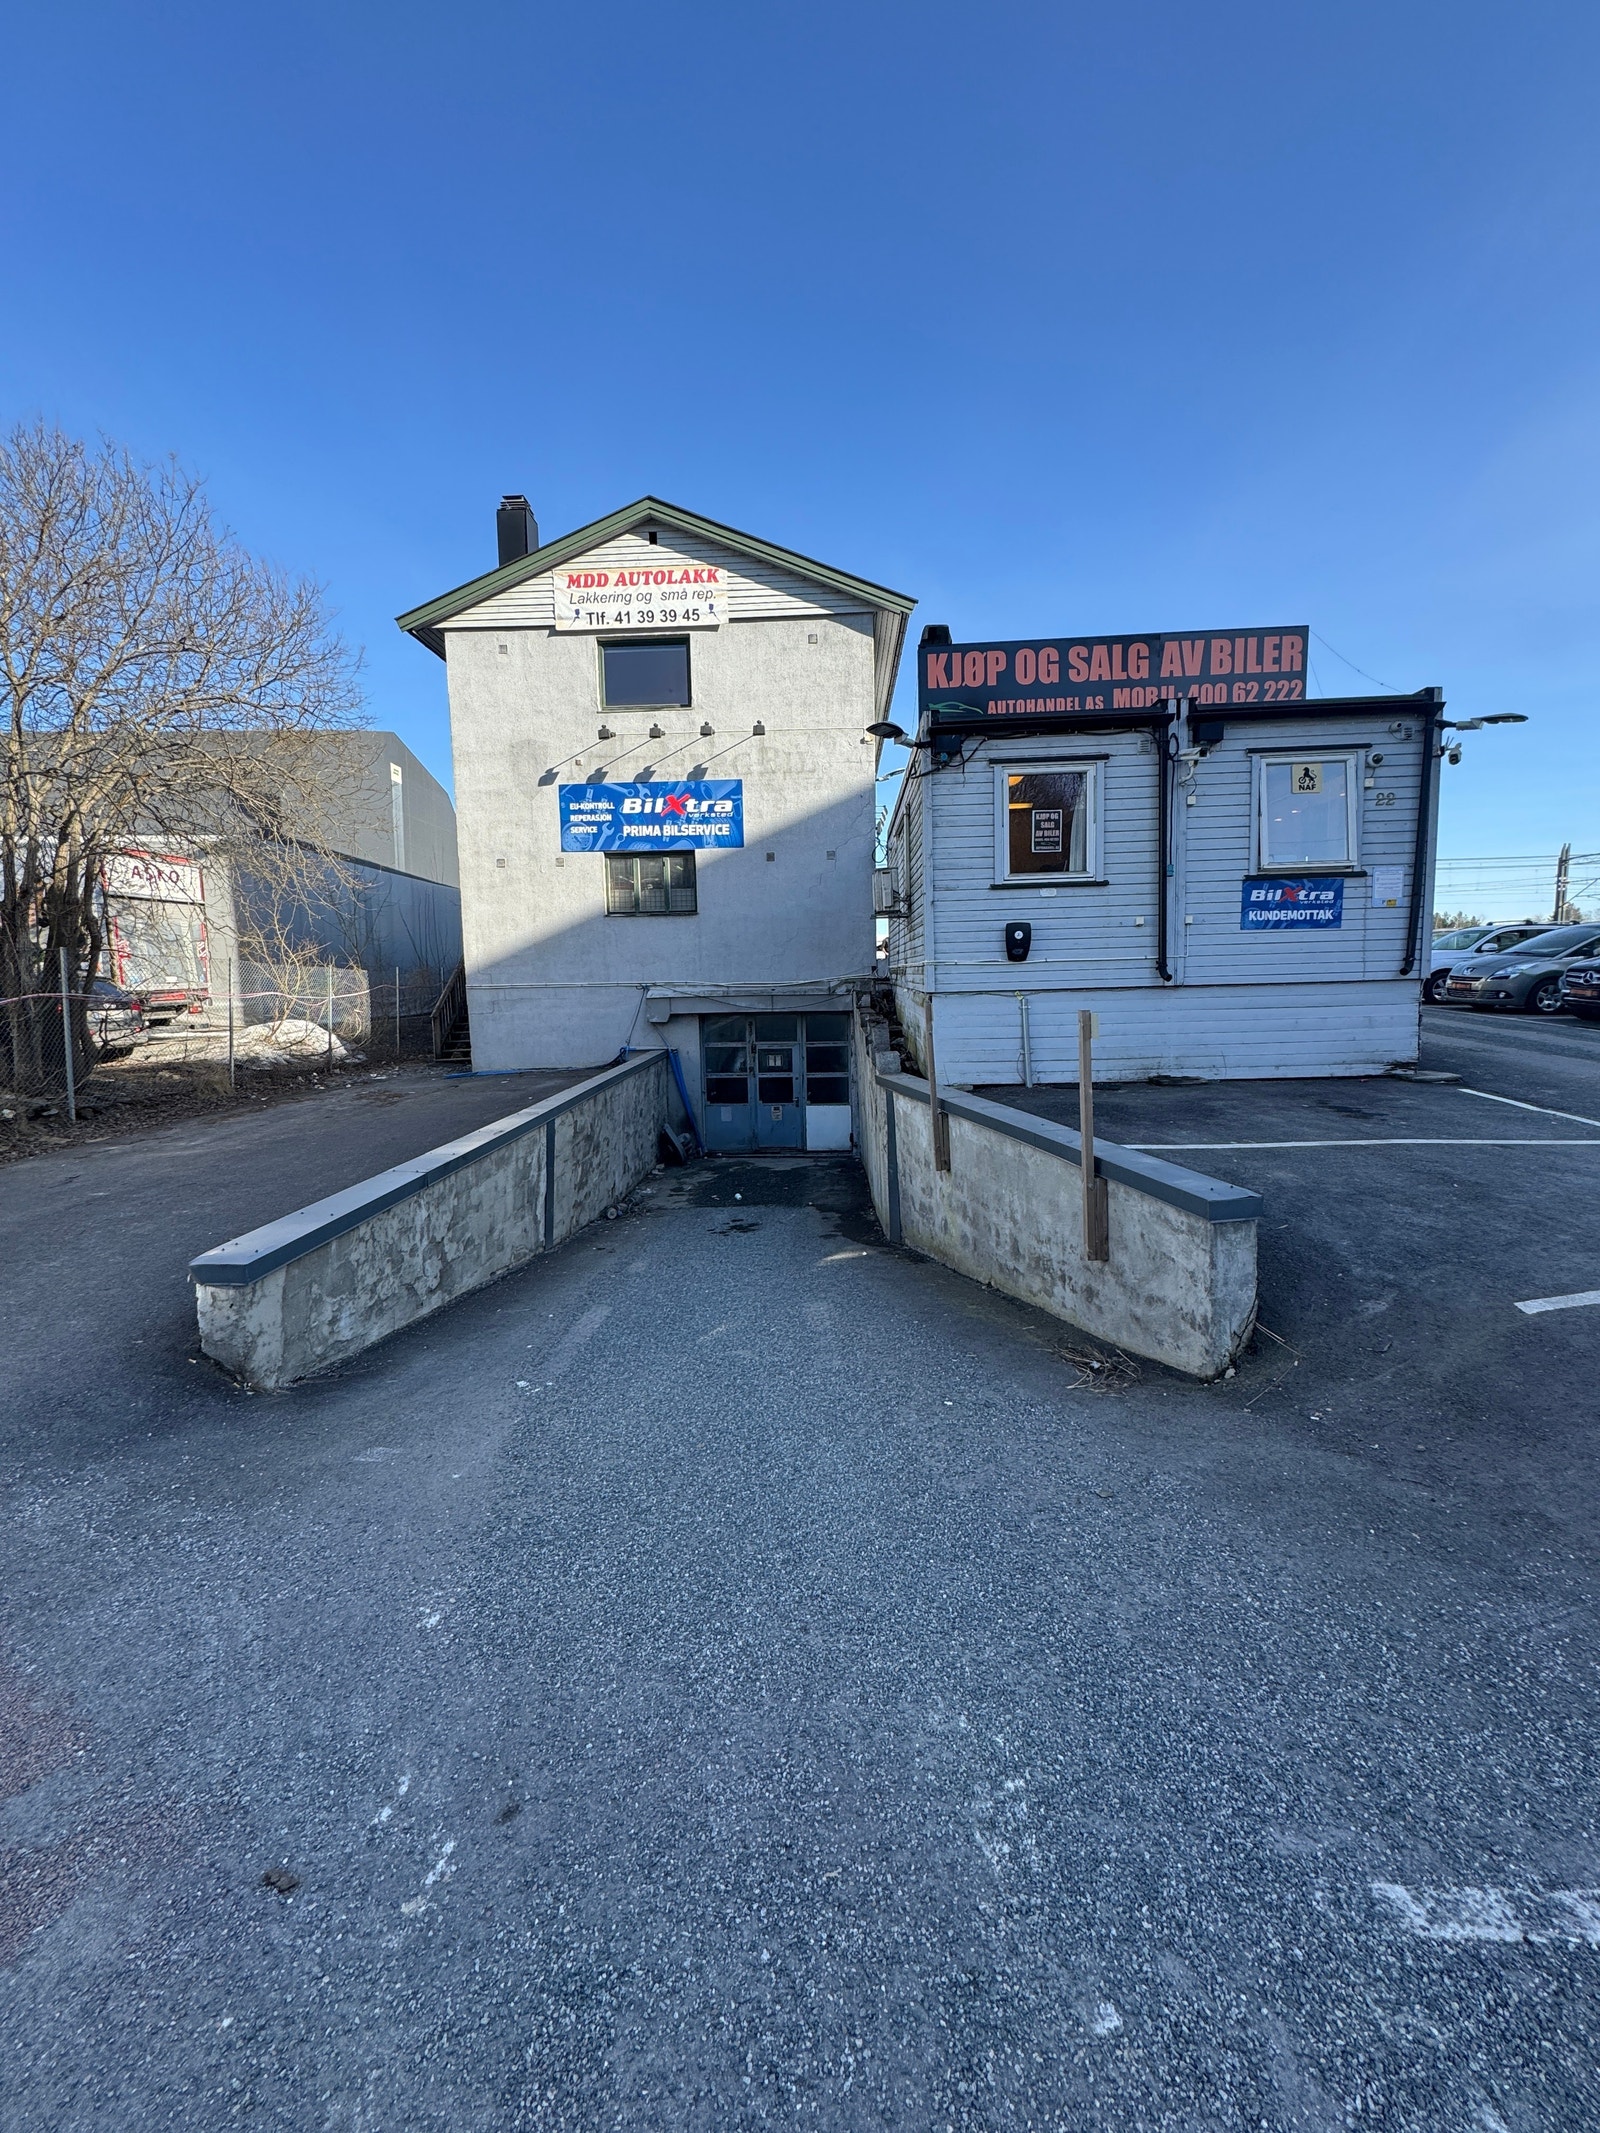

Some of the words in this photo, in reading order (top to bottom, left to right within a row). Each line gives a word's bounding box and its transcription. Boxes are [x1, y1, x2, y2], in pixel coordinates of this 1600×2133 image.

[566, 573, 608, 588] MDD
[614, 569, 720, 586] AUTOLAKK
[570, 591, 631, 605] Lakkering
[636, 592, 652, 603] og
[660, 588, 687, 601] små
[692, 590, 716, 603] rep.
[586, 612, 610, 625] Tlf.
[615, 611, 631, 624] 41
[637, 610, 655, 623] 39
[660, 609, 677, 622] 39
[682, 609, 700, 621] 45
[927, 650, 1006, 689] KJØP
[1015, 646, 1060, 686] OG
[1068, 642, 1150, 683] SALG
[1160, 639, 1205, 678] AV
[1210, 635, 1304, 676] BILER
[987, 696, 1081, 714] AUTOHANDEL
[1085, 695, 1104, 710] AS
[1188, 684, 1228, 705] 400
[1232, 681, 1259, 703] 62
[1263, 679, 1304, 702] 222
[570, 802, 615, 810] EU-KONTROLL
[622, 794, 734, 816] BilXtra
[1375, 792, 1395, 806] 22
[570, 825, 598, 834] SERVICE
[623, 825, 661, 837] PRIMA
[663, 824, 730, 836] BILSERVICE
[1250, 887, 1334, 902] BilXtra
[1248, 910, 1334, 921] KUNDEMOTTAK
